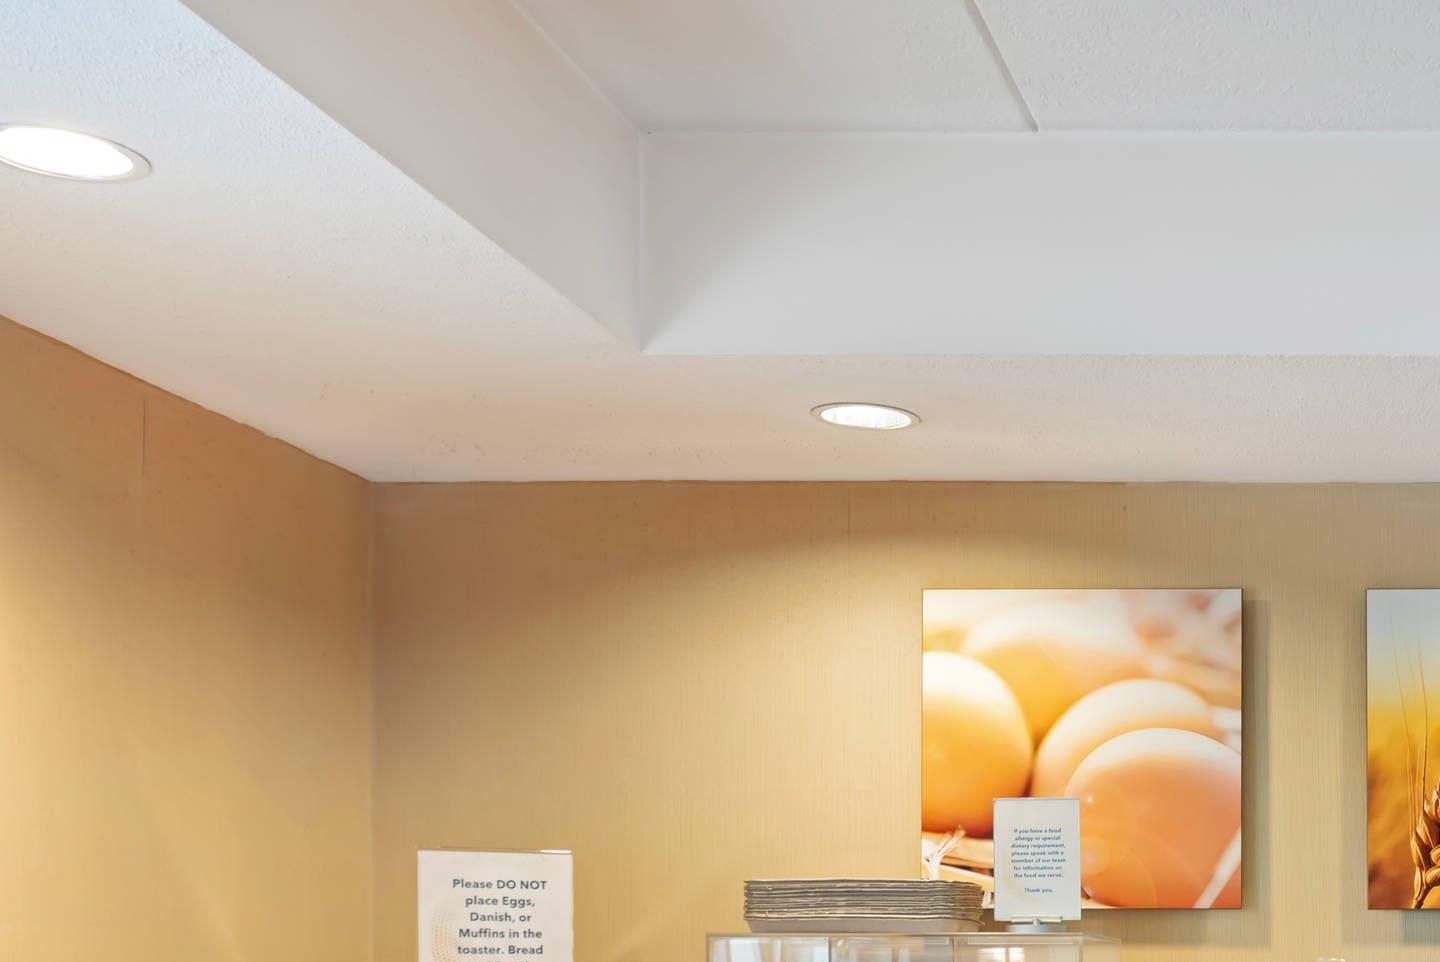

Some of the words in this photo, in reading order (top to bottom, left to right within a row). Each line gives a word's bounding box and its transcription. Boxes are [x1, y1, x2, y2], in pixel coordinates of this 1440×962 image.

[452, 878, 493, 890] Please
[496, 880, 517, 890] DO
[519, 880, 547, 890] NOT
[465, 895, 498, 908] place
[502, 896, 535, 909] Eggs,
[469, 911, 516, 923] Danish,
[518, 914, 532, 922] or
[458, 928, 505, 939] Muffins
[508, 928, 519, 939] in
[523, 928, 543, 939] the
[457, 946, 504, 955] toaster.
[508, 945, 544, 955] Bread
